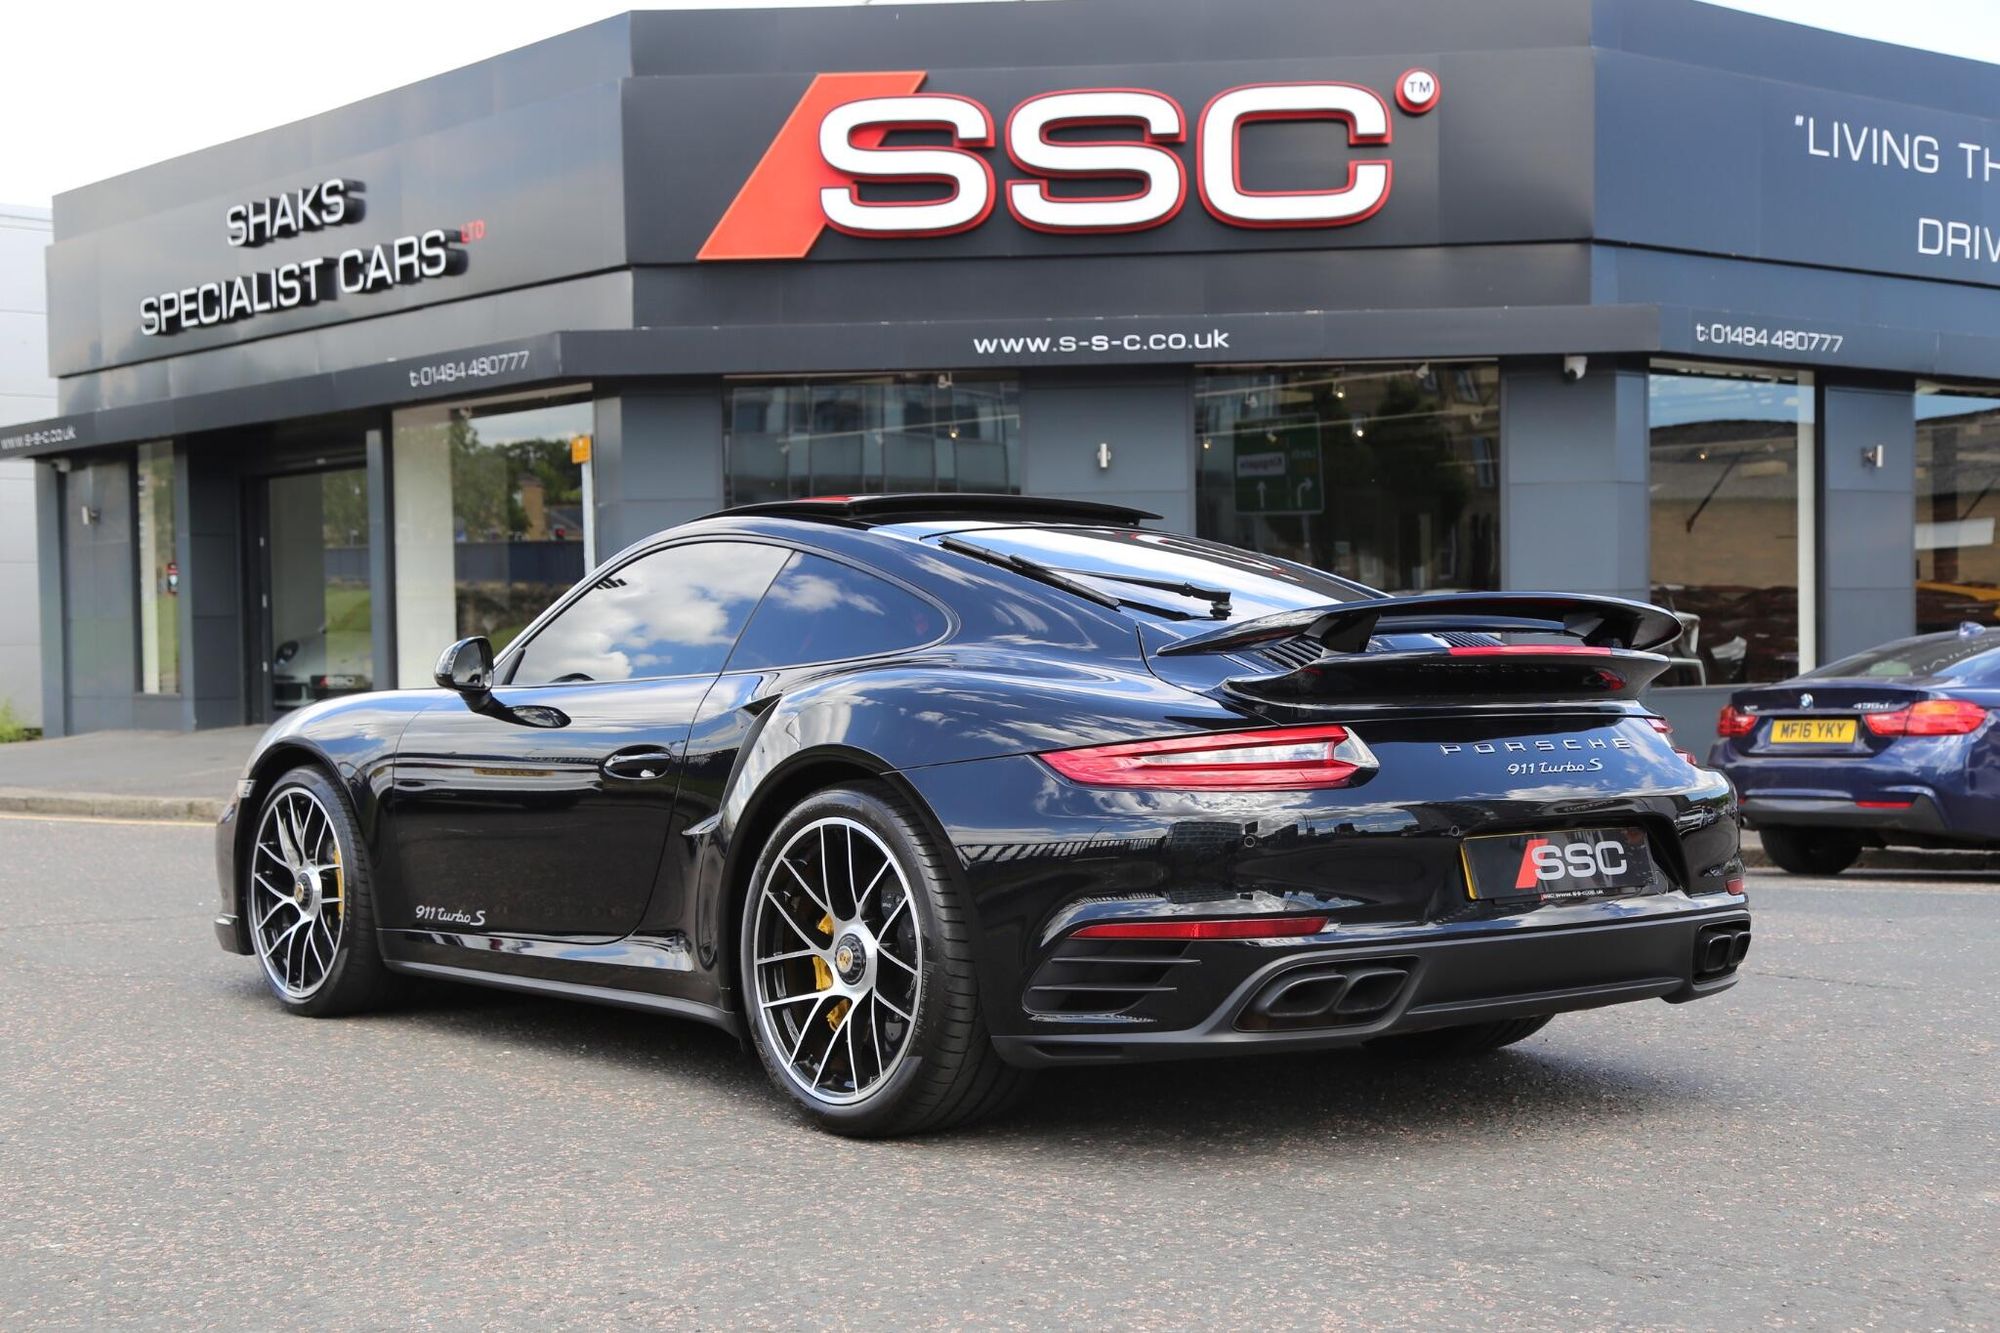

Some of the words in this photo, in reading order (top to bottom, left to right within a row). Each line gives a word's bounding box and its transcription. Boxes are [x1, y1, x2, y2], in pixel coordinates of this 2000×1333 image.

[817, 80, 1393, 238] SSC
[1408, 81, 1431, 93] TM
[226, 178, 346, 247] SHAKS
[139, 257, 325, 336] SPECIALIST
[338, 229, 447, 294] CARS
[460, 219, 486, 243] LTD
[973, 328, 1230, 354] www.s-s-c.co.uk
[1780, 722, 1813, 738] MF16
[1817, 722, 1847, 738] YKY
[1440, 737, 1632, 755] PORSCHE
[1507, 763, 1536, 775] 911
[1586, 757, 1604, 771] S
[1531, 840, 1627, 881] SSC
[415, 905, 436, 920] 911
[469, 910, 486, 926] S
